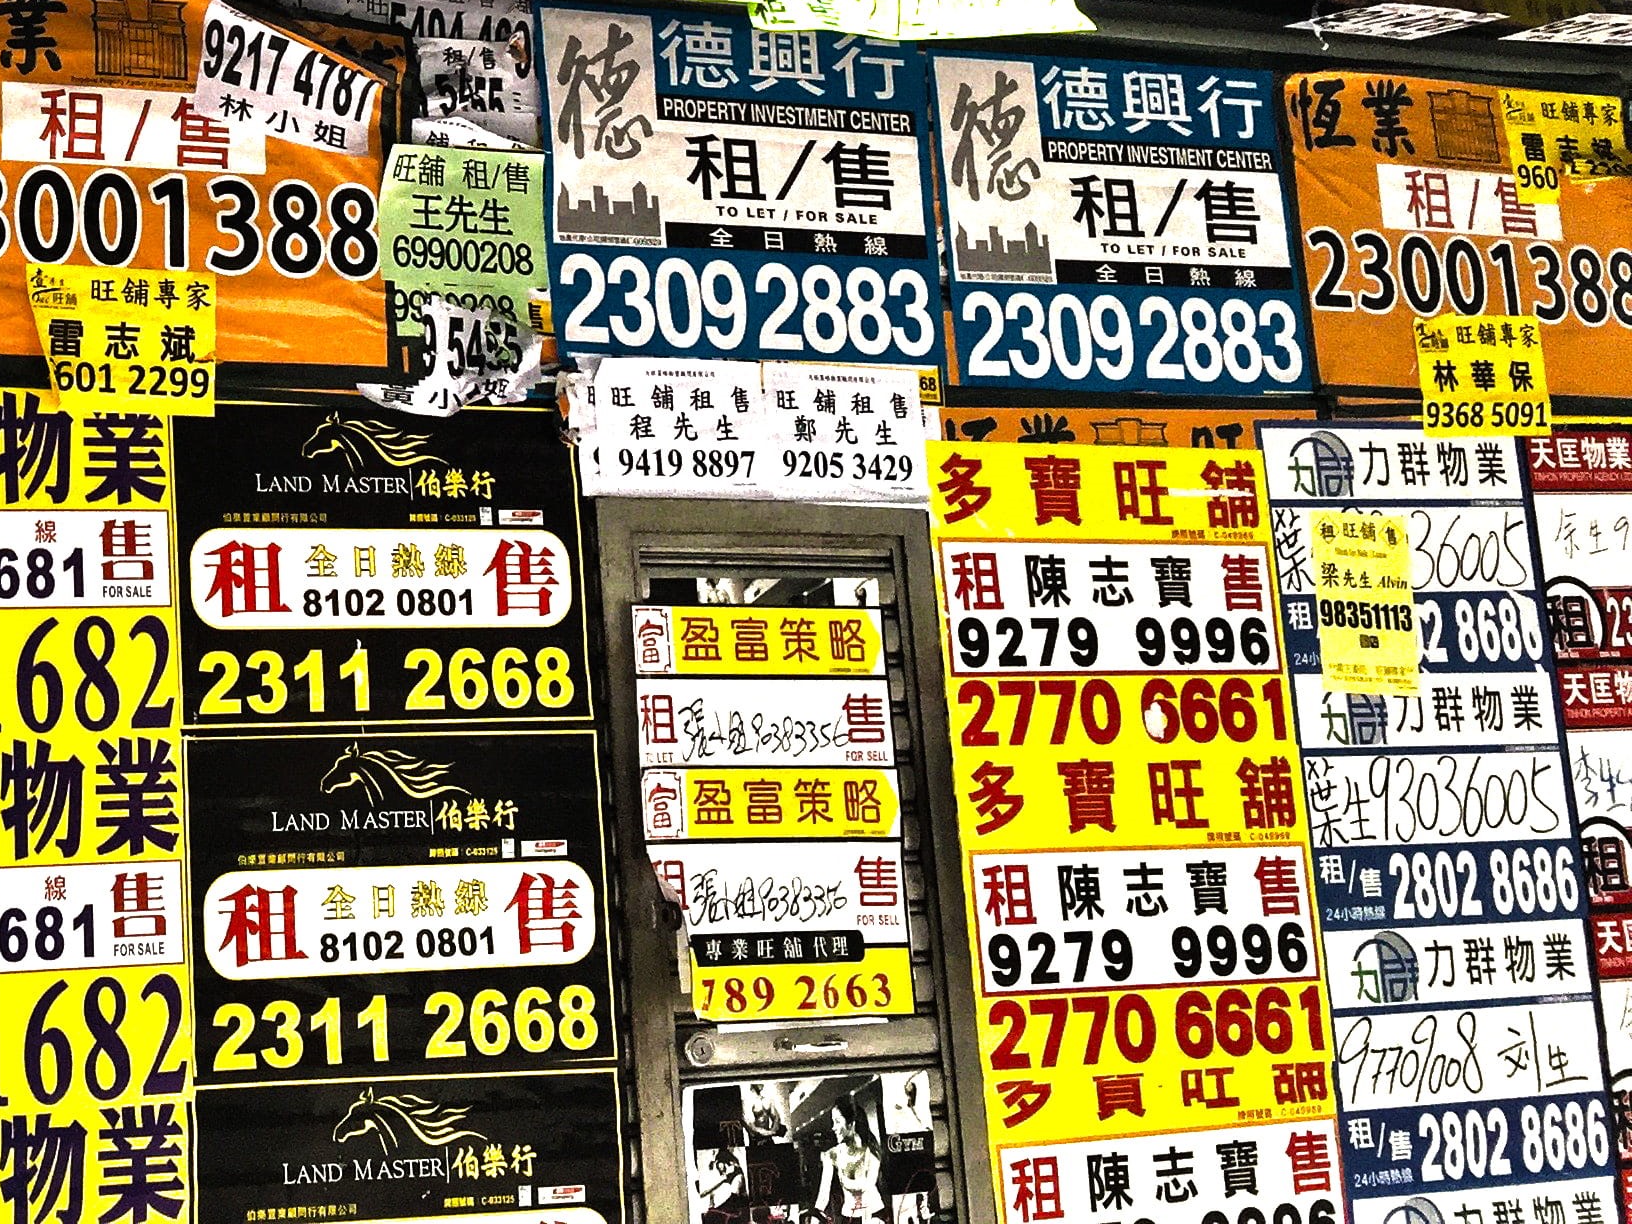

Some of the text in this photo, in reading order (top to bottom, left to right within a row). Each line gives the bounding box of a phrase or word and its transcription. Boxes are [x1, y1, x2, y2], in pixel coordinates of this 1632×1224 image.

[203, 18, 291, 96] 9217
[656, 19, 905, 100] 德興行
[219, 92, 349, 151] 林小姐
[663, 98, 911, 133] PROPERTY INVESTMENT CENTER
[1040, 64, 1264, 138] 德興行
[462, 158, 532, 195] 租/售
[685, 133, 896, 211] 租/售
[410, 194, 514, 237] 王先生
[715, 205, 878, 226] TO LET FOR SALE
[392, 236, 535, 277] 69900208
[709, 228, 890, 256] 全日熱線
[90, 278, 213, 309] 旺舖專家
[559, 253, 936, 357] 2309 2883
[46, 317, 197, 363] 雷志斌
[962, 290, 1304, 385] 2309 2883
[1453, 322, 1539, 349] 旺舖專家
[127, 367, 211, 399] 2299
[1431, 361, 1534, 393] 林華保
[611, 384, 751, 413] 旺舖租售
[1424, 401, 1549, 430] 9368 5091
[629, 412, 739, 441] 程先生
[794, 415, 899, 446] 鄭先生
[618, 448, 755, 479] 9419 8897
[782, 449, 914, 483] 9205 3429
[1358, 441, 1508, 488] 力群物業
[255, 469, 497, 500] LAND MASTER 伯樂行
[937, 452, 1261, 529] 多寶旺舖
[304, 542, 468, 579] 全日熱線
[302, 587, 474, 617] 8102 0801
[1024, 554, 1194, 609] 陳志寶
[680, 615, 868, 663] 盈富策略
[957, 615, 1271, 669] 9279 9996
[197, 645, 575, 715] 2311 2668
[956, 676, 1288, 748] 2770 6661
[1388, 845, 1580, 921] 2802 8686
[704, 935, 850, 962] 專業旺舖代理
[1424, 932, 1576, 988] 力群物業
[796, 972, 893, 1010] 2663
[211, 984, 599, 1073] 2311 2668
